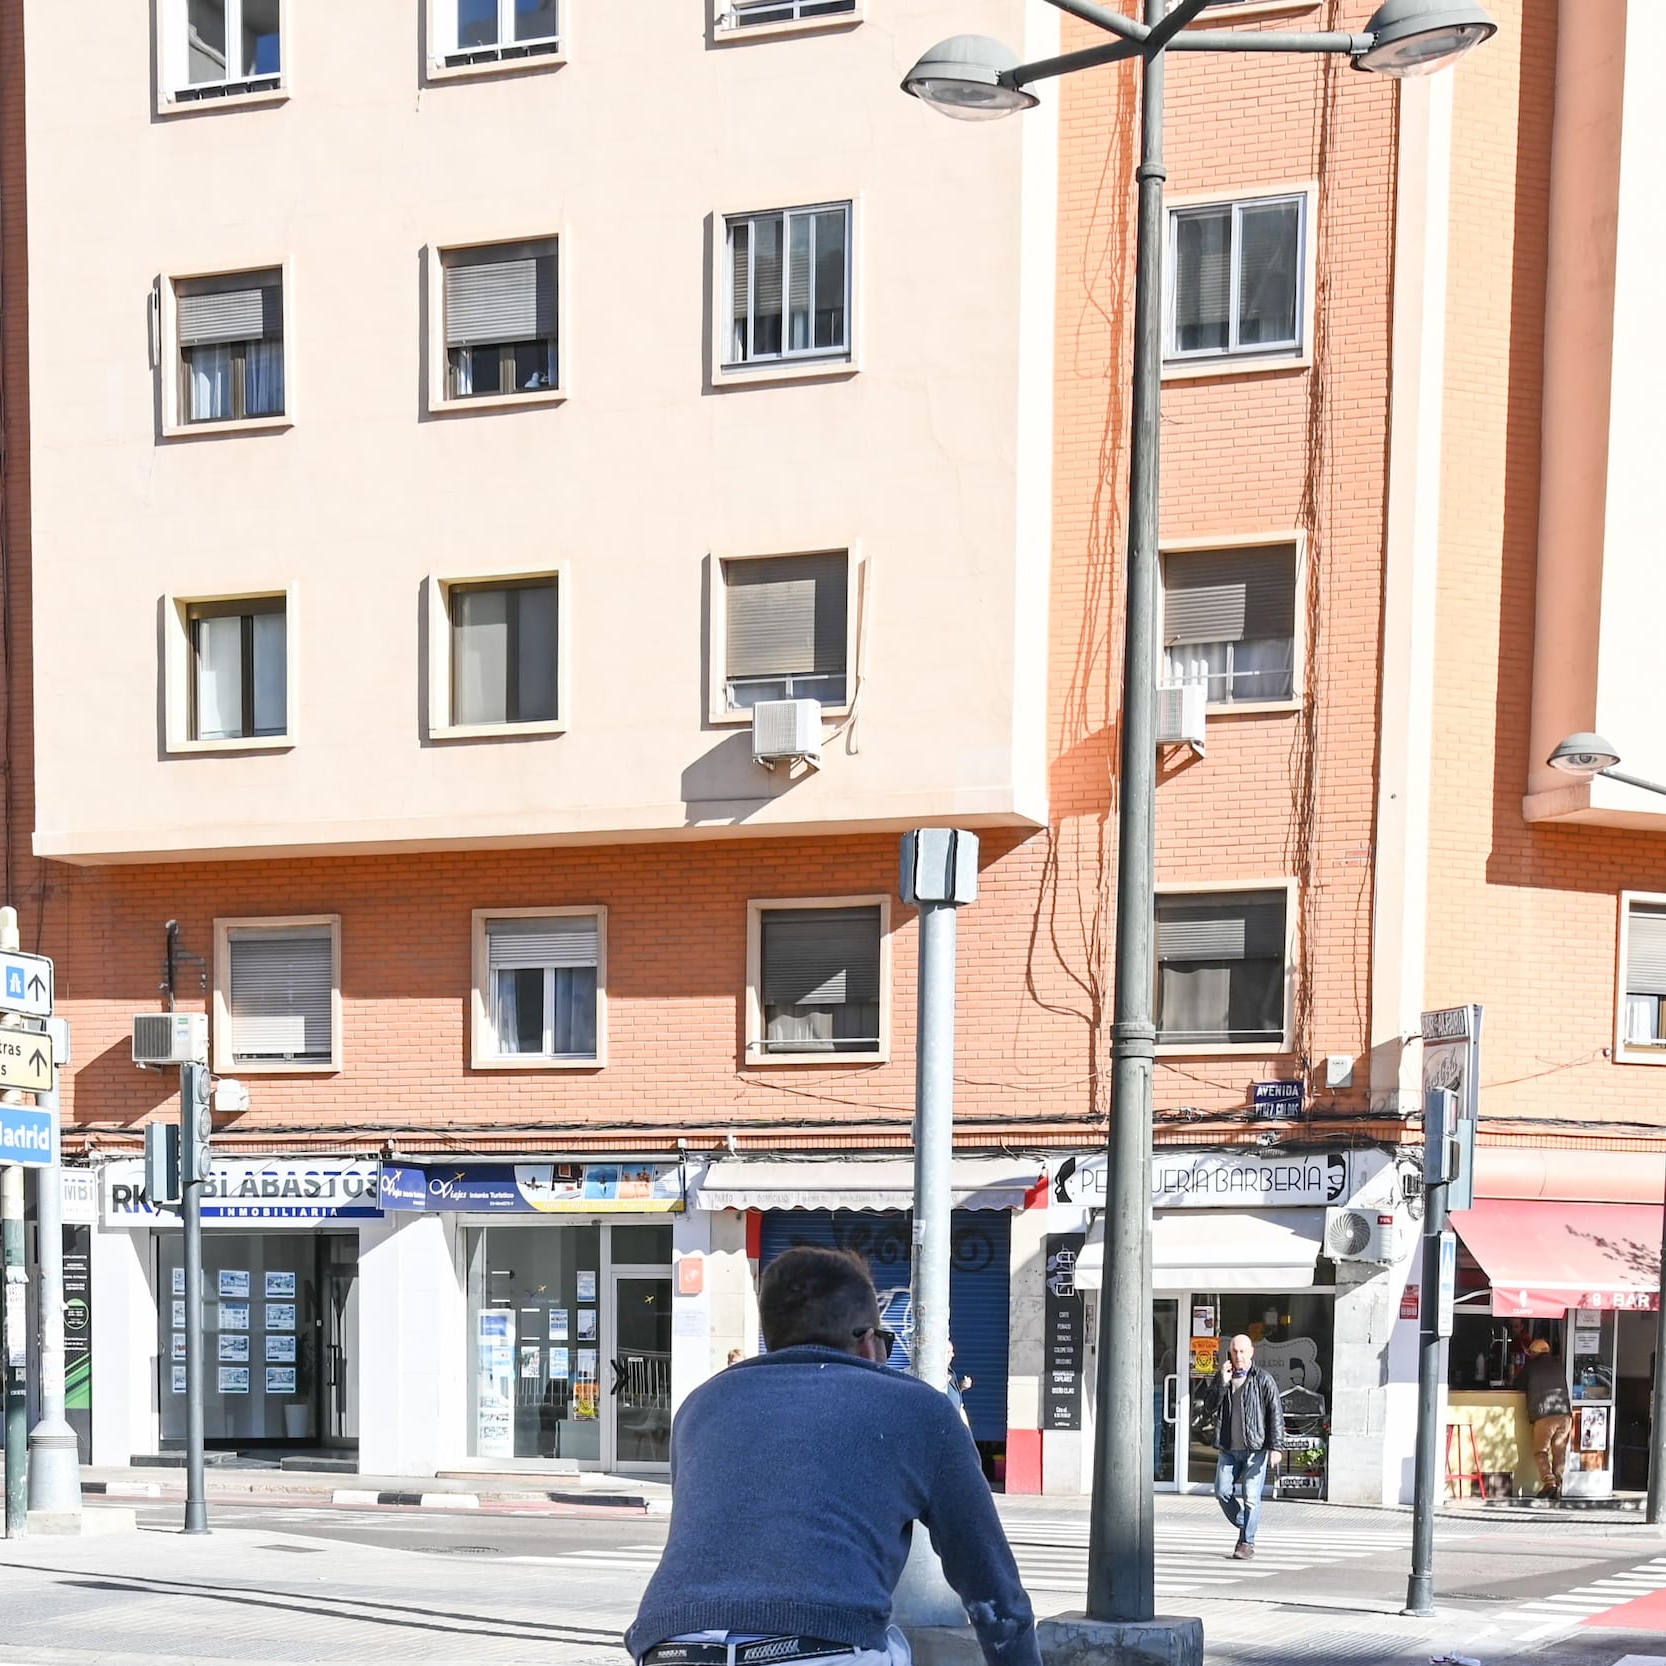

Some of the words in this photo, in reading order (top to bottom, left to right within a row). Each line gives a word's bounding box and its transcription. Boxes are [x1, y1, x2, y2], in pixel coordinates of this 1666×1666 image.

[1256, 1085, 1299, 1097] AVENIDA
[1215, 1156, 1321, 1193] BARBERÍA
[220, 1207, 338, 1217] INMOBILIARIA
[1613, 1293, 1650, 1308] BAR
[1284, 1440, 1309, 1448] GARDEN
